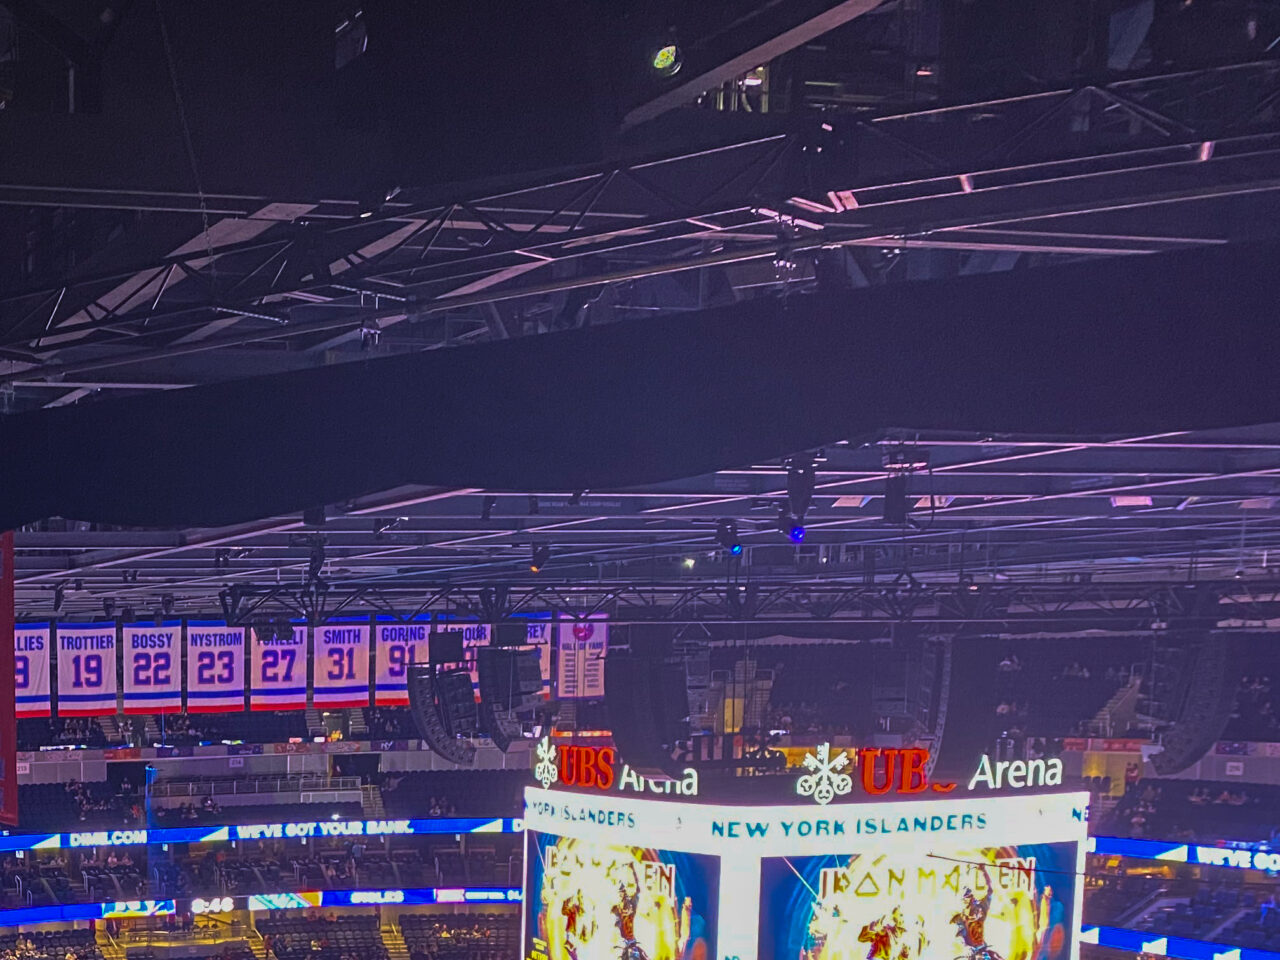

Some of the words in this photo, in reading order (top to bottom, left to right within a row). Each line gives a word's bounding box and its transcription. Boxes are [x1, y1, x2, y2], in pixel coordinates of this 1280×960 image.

[60, 634, 114, 650] TROTTIER
[132, 634, 173, 649] BOSSY
[190, 632, 242, 647] NYSTROM
[323, 628, 361, 644] SMITH
[72, 654, 103, 688] 19
[133, 652, 171, 686] 22
[197, 651, 235, 684] 23
[261, 649, 297, 682] 27
[327, 647, 356, 680] 31
[388, 645, 416, 677] 91
[558, 745, 614, 789] UBS
[860, 748, 956, 794] UB
[967, 754, 1063, 790] Arena
[320, 821, 365, 835] YOUR
[561, 805, 635, 828] ISLANDERS
[711, 820, 769, 838] NEW
[780, 819, 846, 836] YORK
[856, 813, 987, 834] ISLANDERS
